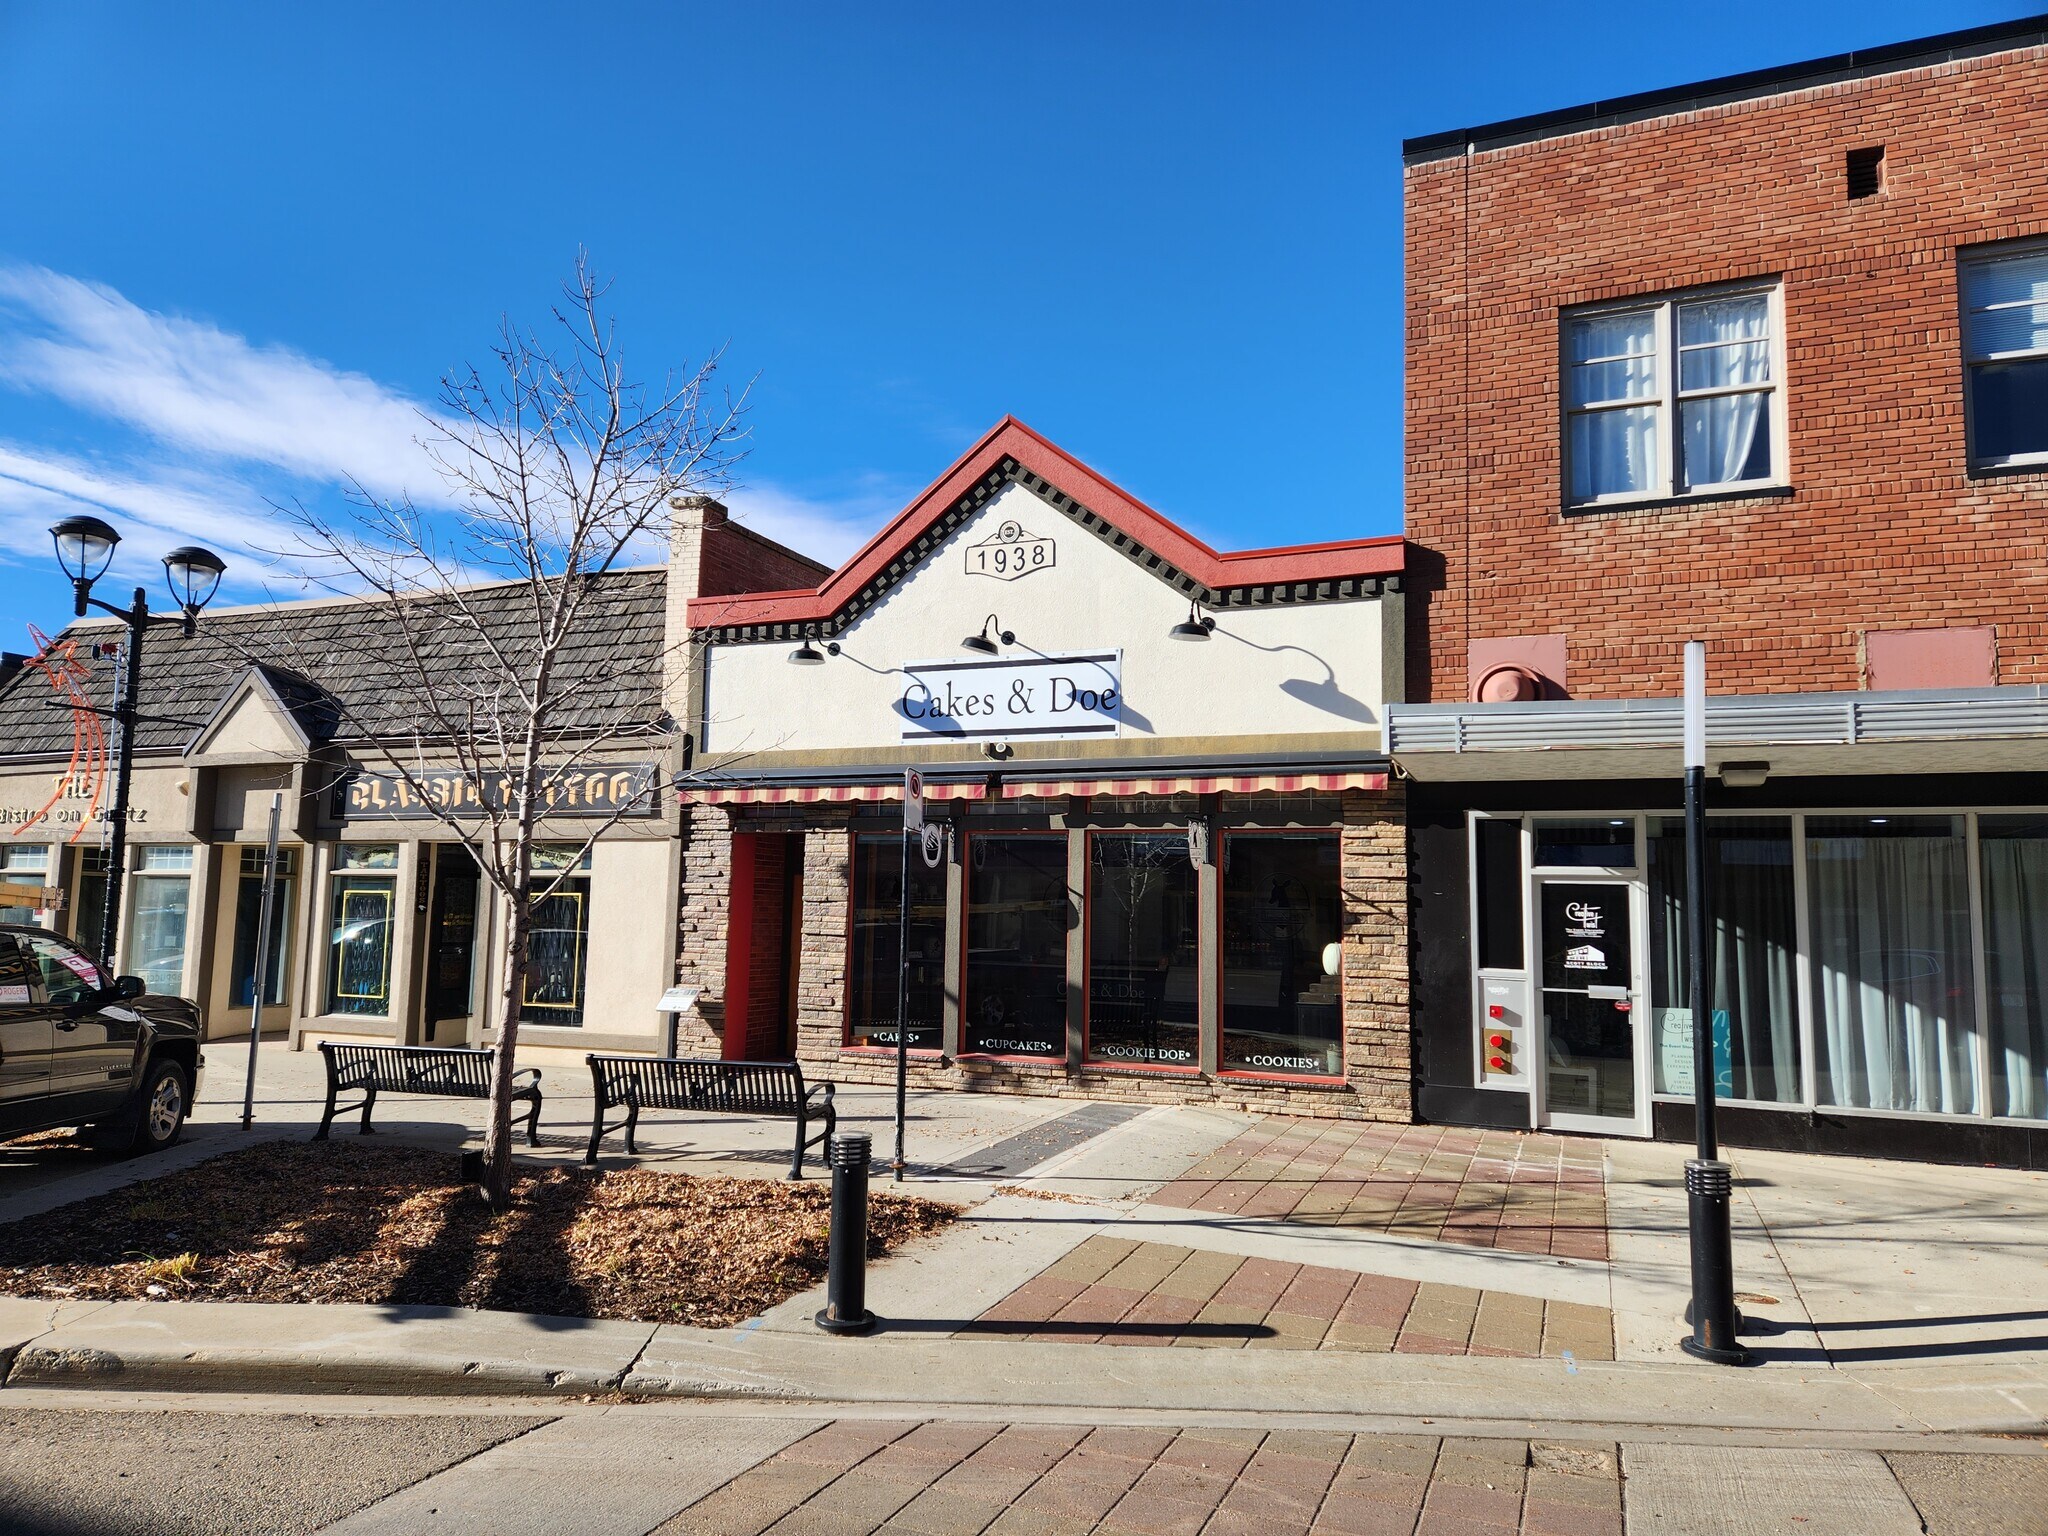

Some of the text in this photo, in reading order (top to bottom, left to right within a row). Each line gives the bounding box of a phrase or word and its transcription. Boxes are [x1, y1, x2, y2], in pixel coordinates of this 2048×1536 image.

[978, 545, 1044, 573] 1938
[902, 677, 1117, 719] Cakes & Doe
[498, 771, 632, 807] TTTOO
[56, 810, 80, 823] on
[419, 862, 428, 903] TATTOOS
[3, 987, 27, 995] ROGERS
[879, 1032, 914, 1043] CAKS
[985, 1038, 1047, 1052] CUPCAKES
[1107, 1046, 1186, 1060] COOKIE DOE
[1253, 1055, 1314, 1069] COOKIES
